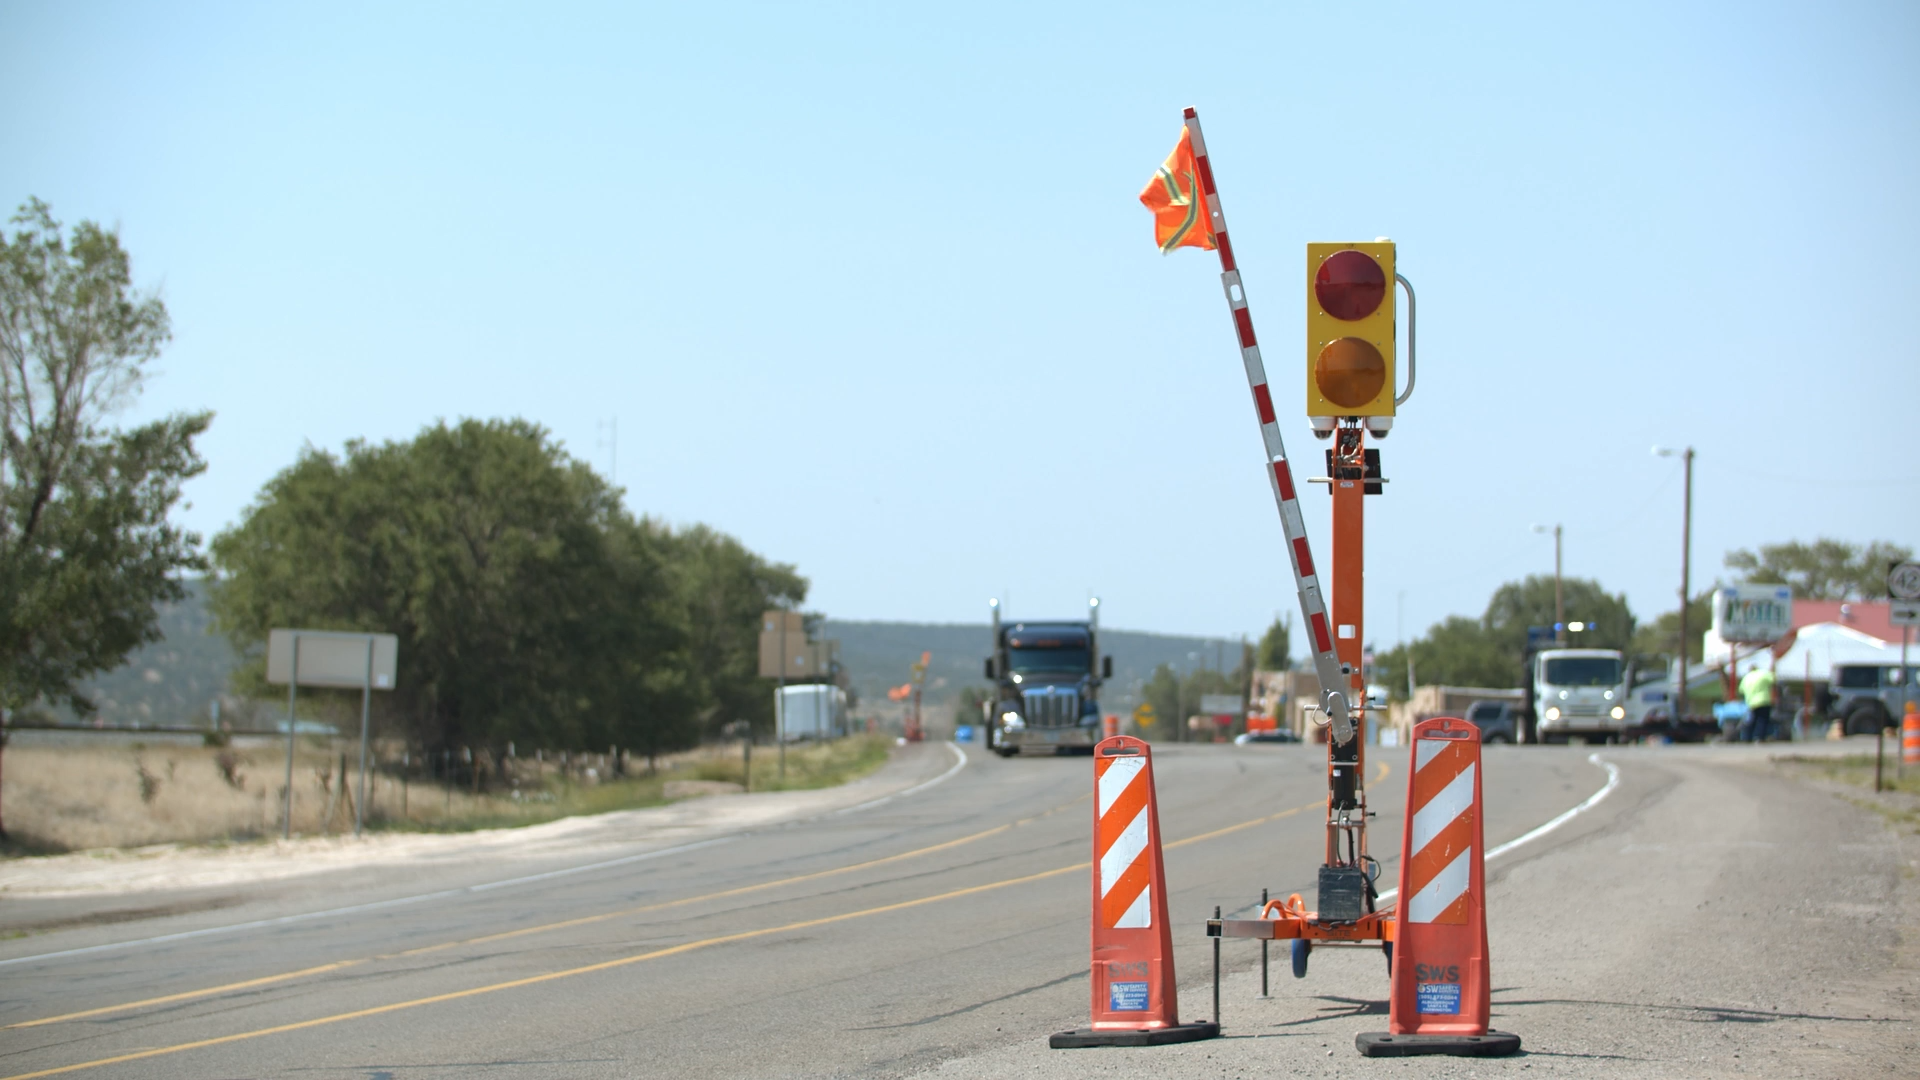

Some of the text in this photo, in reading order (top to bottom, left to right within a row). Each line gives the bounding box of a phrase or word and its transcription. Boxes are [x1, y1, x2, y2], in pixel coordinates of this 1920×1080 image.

[1109, 961, 1148, 978] SWS
[1415, 963, 1460, 983] SWS
[1426, 985, 1439, 993] SW
